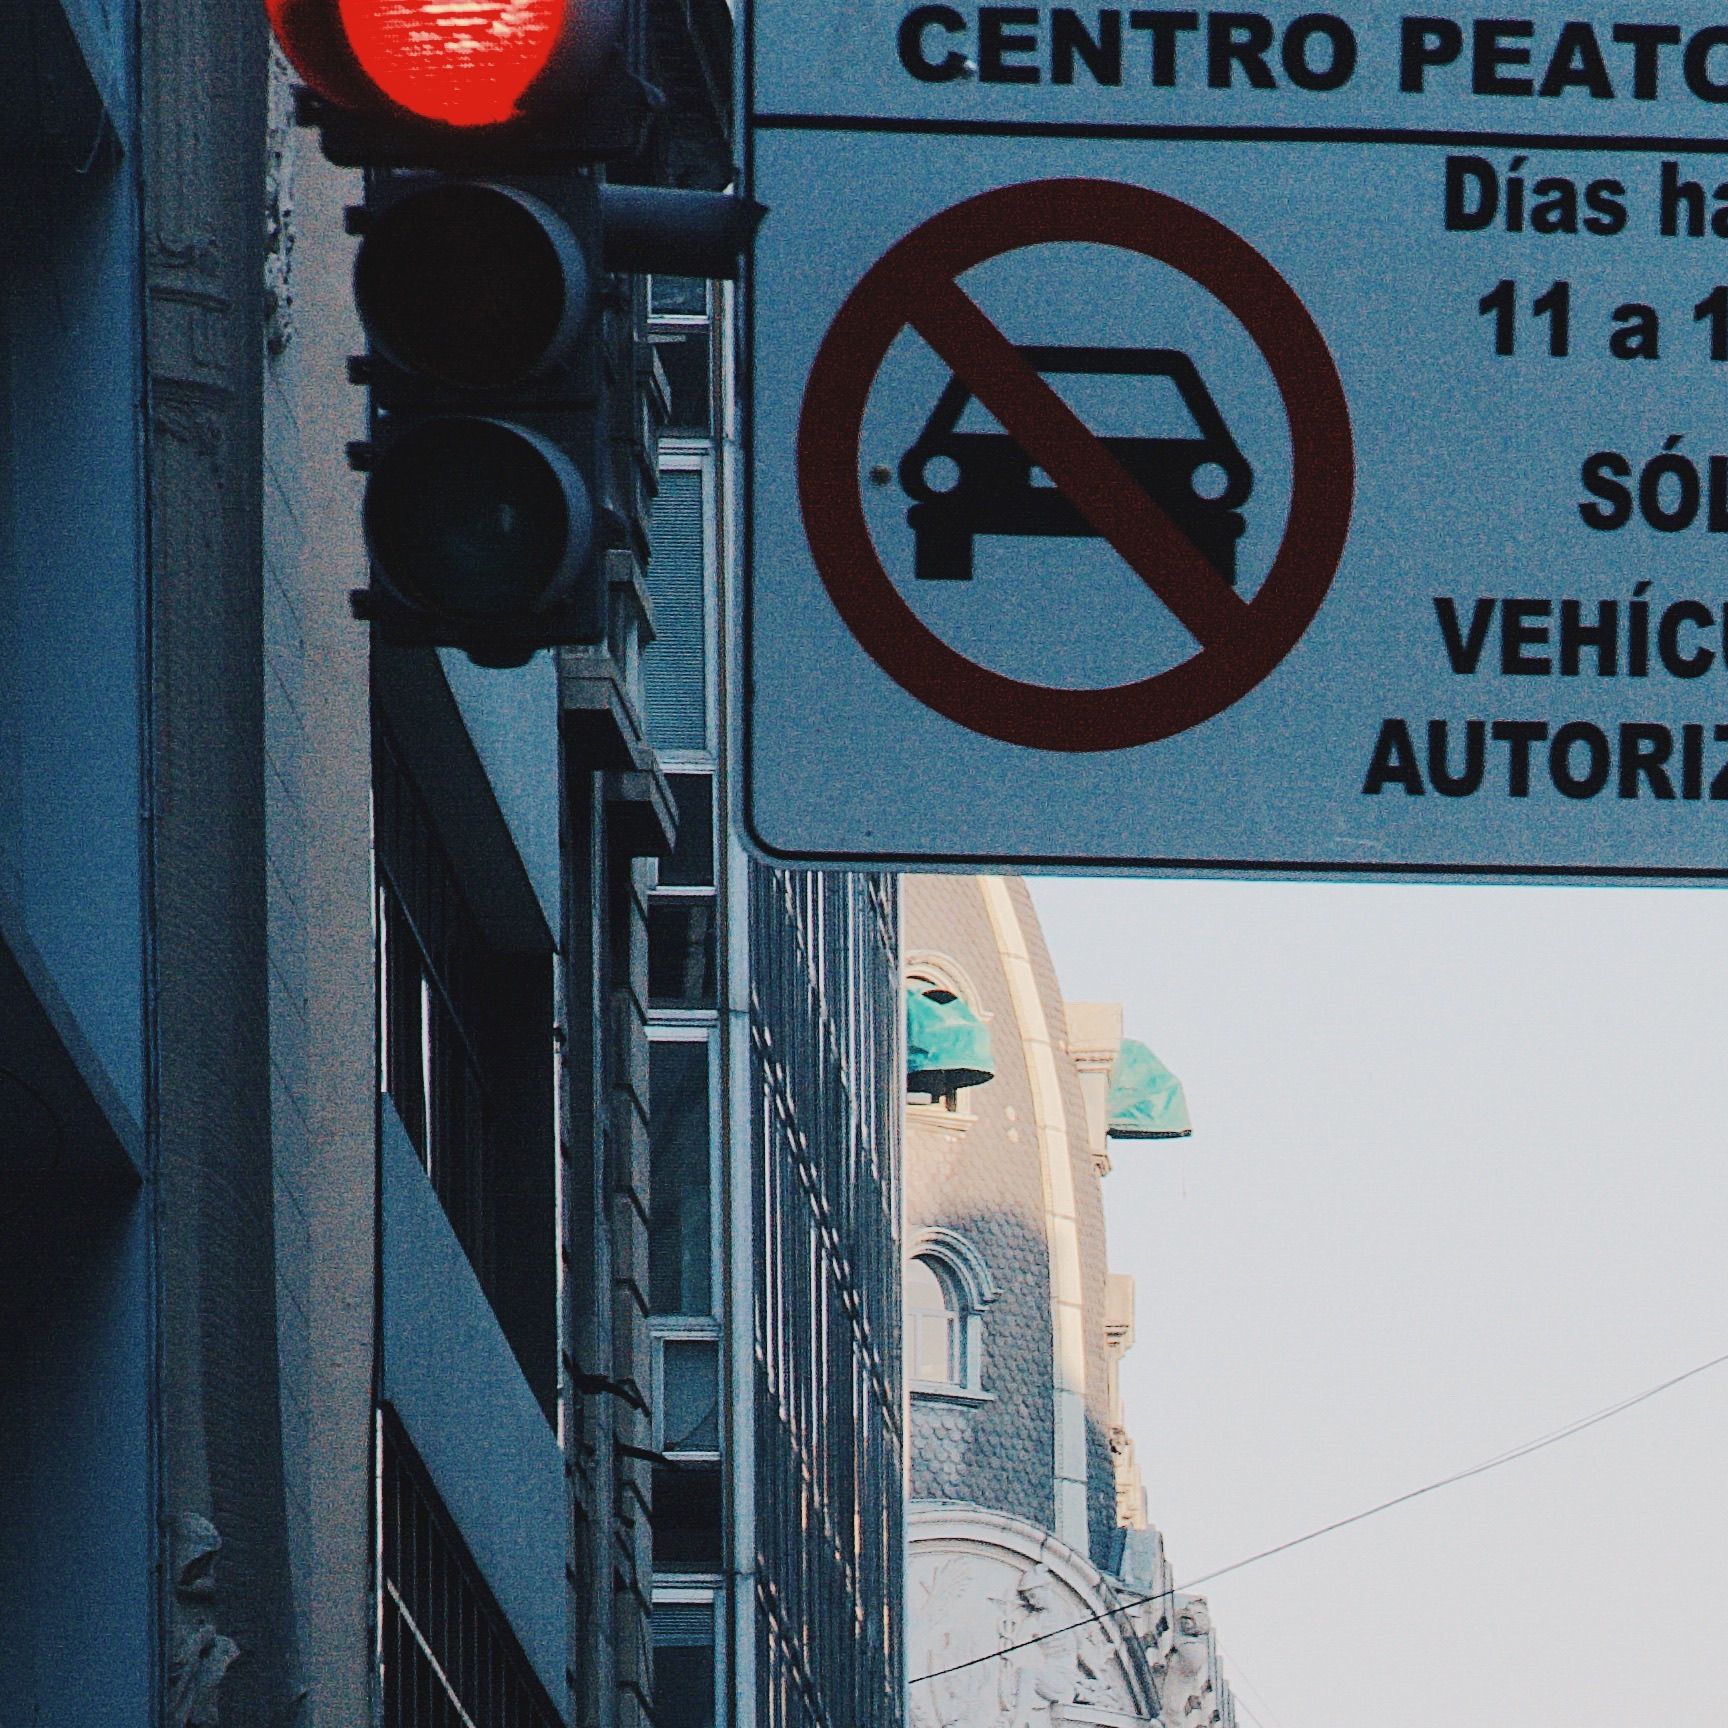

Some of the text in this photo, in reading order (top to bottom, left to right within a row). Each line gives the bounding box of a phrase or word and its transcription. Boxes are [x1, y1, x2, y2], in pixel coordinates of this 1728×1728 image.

[897, 4, 1357, 92] CENTRO
[1443, 155, 1629, 237] Días
[1478, 280, 1570, 358] 11
[1609, 304, 1660, 361] a
